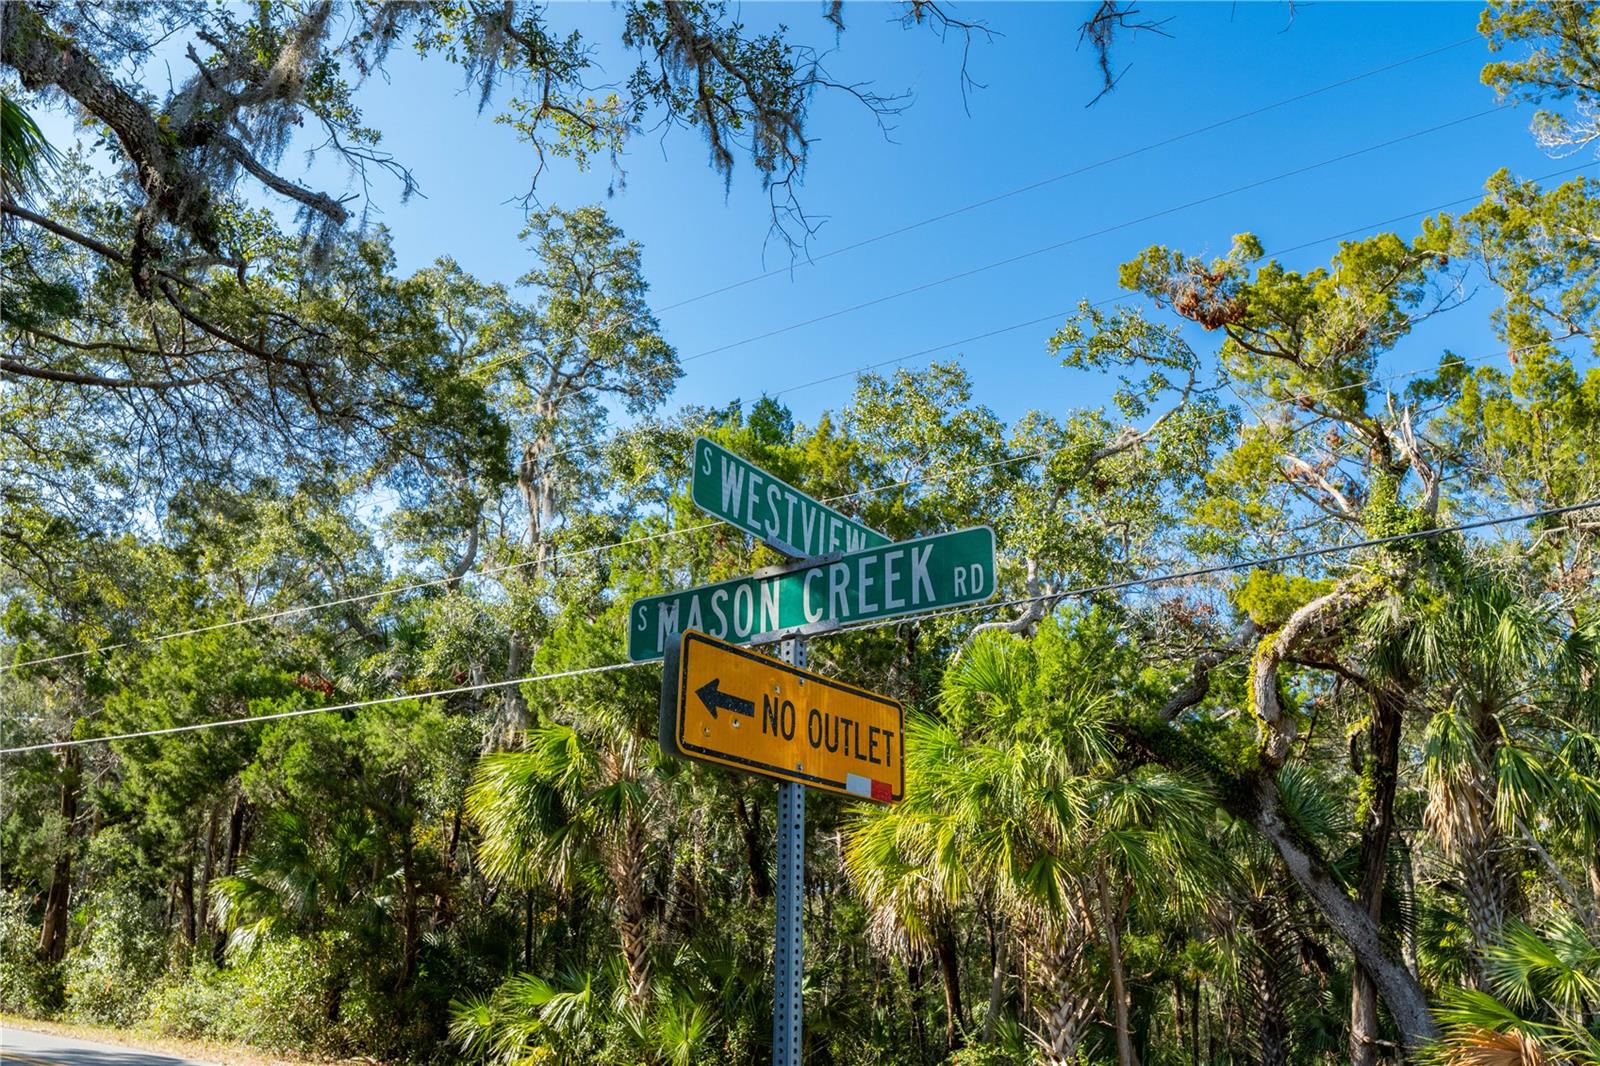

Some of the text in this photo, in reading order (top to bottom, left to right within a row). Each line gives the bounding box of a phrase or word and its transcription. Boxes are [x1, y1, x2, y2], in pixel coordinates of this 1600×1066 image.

[702, 446, 713, 476] S
[638, 543, 985, 653] S MASON CREEK RD
[762, 693, 894, 767] NO OUTLET
